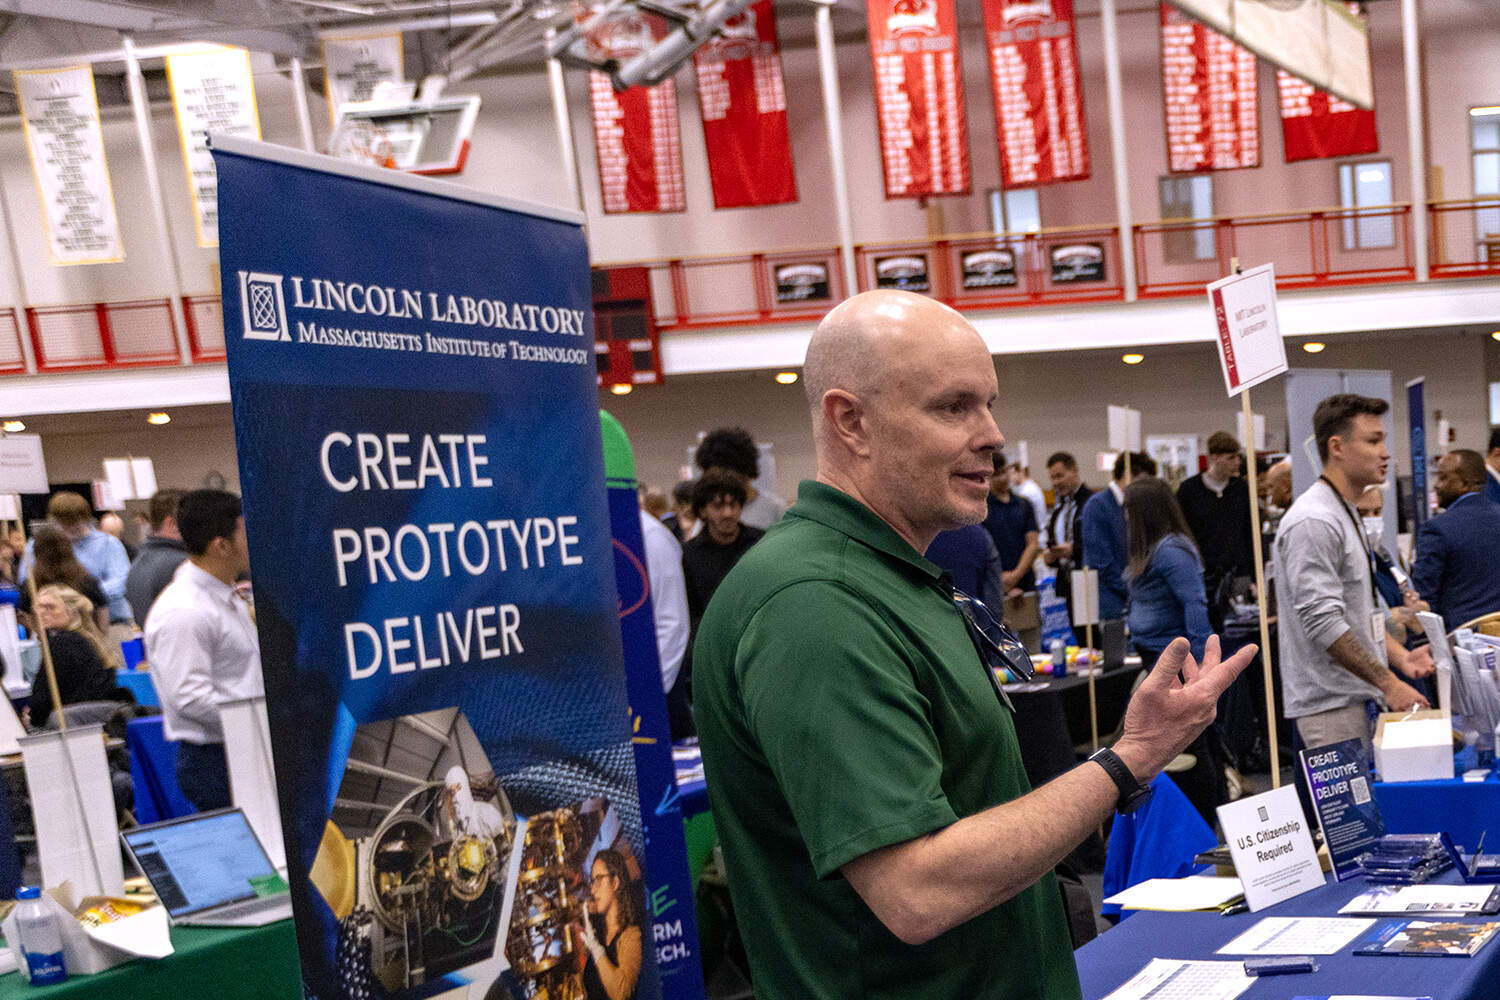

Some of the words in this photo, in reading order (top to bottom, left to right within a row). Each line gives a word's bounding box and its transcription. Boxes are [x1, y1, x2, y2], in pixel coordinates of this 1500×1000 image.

[291, 276, 423, 320] LINCOLN
[429, 292, 585, 336] LABORATORY
[298, 322, 423, 351] MASSACHUSETTS
[426, 332, 491, 358] INSTITUTE
[491, 341, 507, 359] OF
[509, 340, 588, 365] TECHNOLOGY
[320, 431, 494, 493] CREATE
[332, 515, 584, 587] PROTOTYPE
[344, 603, 525, 680] DELIVER
[1308, 751, 1340, 769] CREATE
[1311, 762, 1359, 784] PROTOTYPE
[1316, 781, 1350, 800] DELIVER
[1237, 835, 1256, 850] U.S.
[1256, 820, 1301, 844] Citizenship
[1256, 841, 1294, 863] Required
